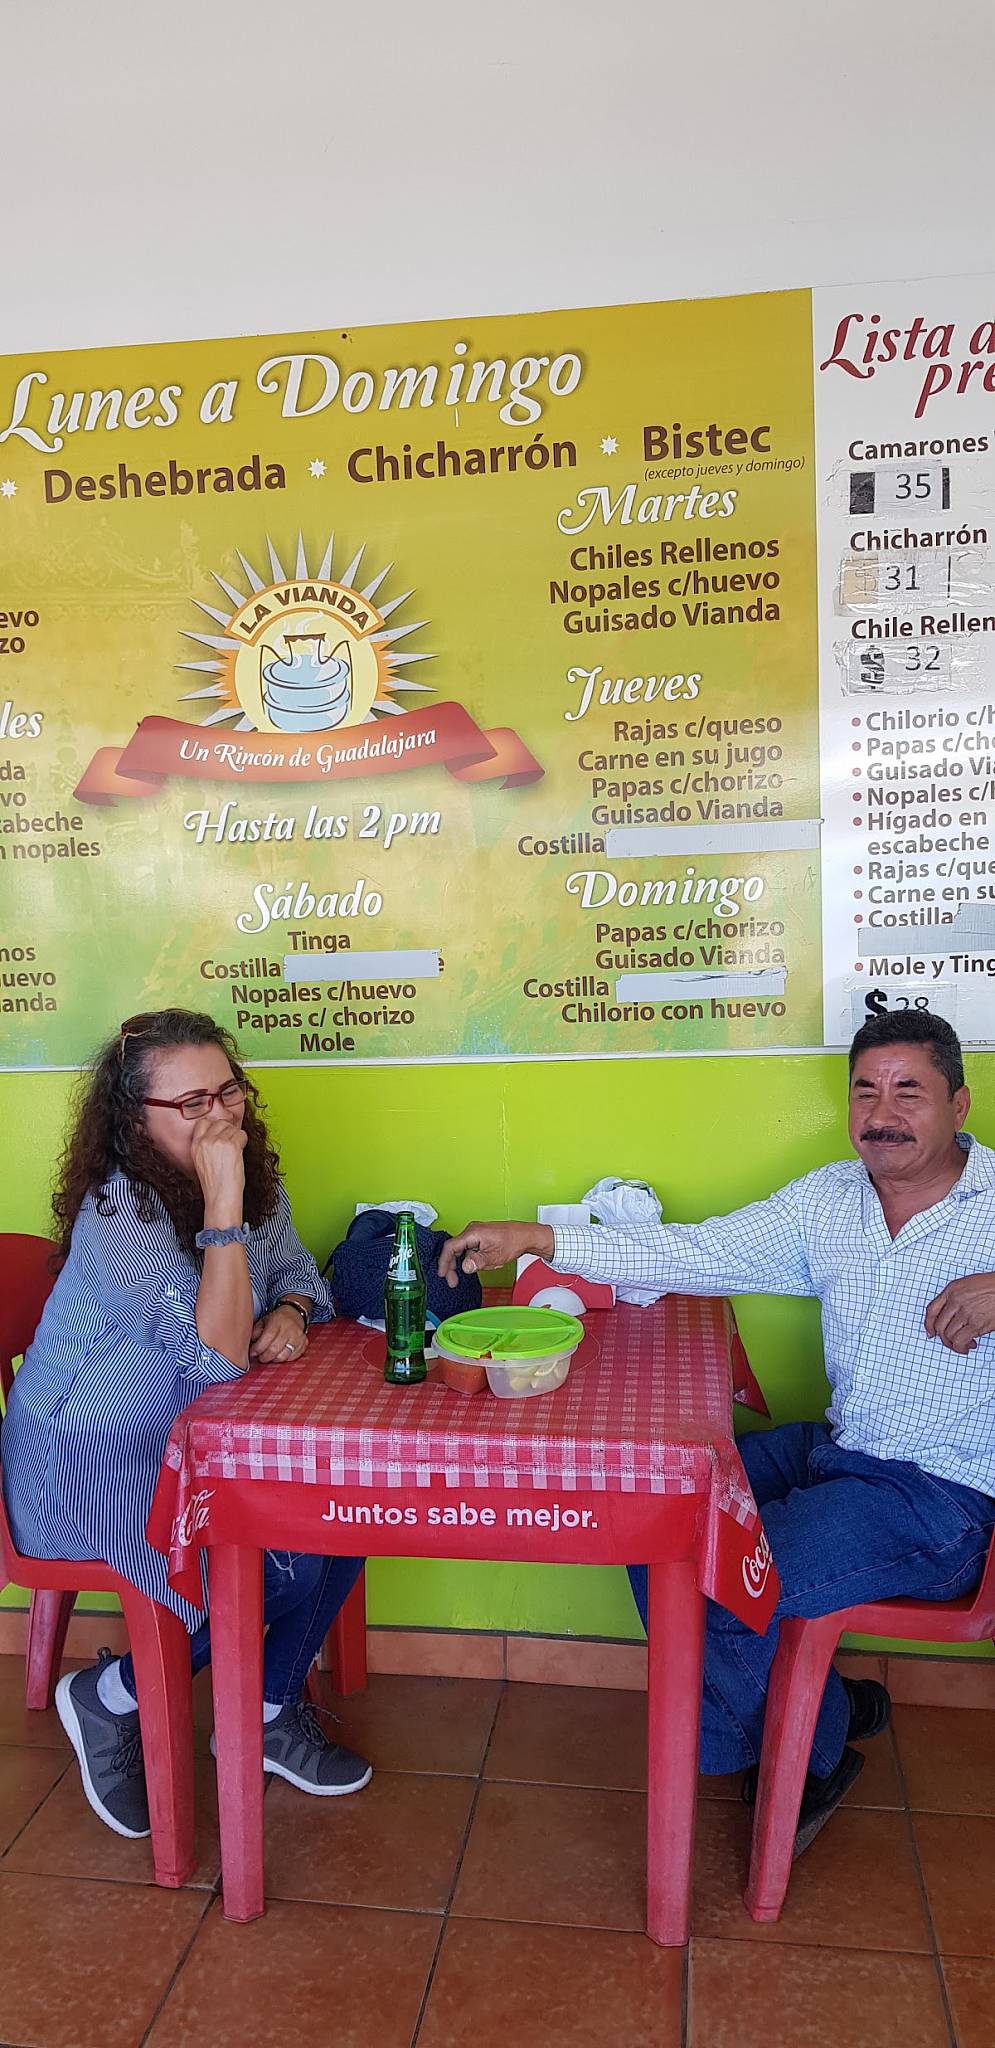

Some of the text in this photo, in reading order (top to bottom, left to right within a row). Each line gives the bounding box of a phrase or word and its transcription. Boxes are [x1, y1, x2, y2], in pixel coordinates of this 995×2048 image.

[820, 313, 955, 379] Lista
[0, 342, 582, 453] Lunes a Domingo
[848, 436, 989, 460] Camarones
[44, 423, 771, 503] Deshebrada Chicharrón Bistec
[644, 456, 805, 481] (excepto jueves y domingo)
[895, 473, 931, 499] 35
[557, 484, 738, 535] Martes
[850, 523, 987, 552] Chicharrón
[570, 537, 779, 571] Chiles Rellenos
[549, 570, 780, 607] Nopales c/huevo
[885, 565, 920, 591] 31
[239, 586, 371, 635] LA VIANDA
[563, 597, 780, 634] Guisado Vianda
[851, 616, 913, 639] Chile
[905, 645, 940, 671] 32
[564, 666, 701, 721] Jueves
[613, 716, 783, 744] Rajas c/queso
[866, 708, 960, 731] Chilorio
[179, 729, 437, 773] Un Rincón de Guadalajara
[578, 744, 783, 772] Carne en su jugo
[867, 737, 936, 760] Papas
[866, 757, 964, 781] Guisado
[591, 770, 783, 801] Papas c/chorizo
[867, 783, 962, 810] Nopales
[0, 811, 83, 834] abeche
[591, 797, 784, 826] Guisado Vianda
[868, 808, 987, 834] Hígado en
[183, 801, 441, 849] Hasta las 2 pm
[13, 837, 101, 863] nopales
[517, 831, 606, 856] Costilla
[867, 831, 989, 856] escabeche
[868, 861, 929, 883] Rajas
[565, 867, 765, 918] Domingo
[868, 885, 935, 904] Carne
[942, 886, 970, 901] en
[236, 880, 383, 934] Sábado
[868, 907, 953, 928] Costilla
[287, 931, 351, 953] Tinga
[595, 918, 785, 947] Papas c/chorizo
[200, 958, 281, 979] Costilla
[595, 943, 785, 970] Guisado Vianda
[869, 957, 926, 976] Mole
[931, 960, 945, 979] y
[0, 972, 56, 987] uevo
[523, 976, 610, 999] Costilla
[231, 981, 417, 1007] Nopales c/huevo
[236, 1006, 415, 1033] Papas c/ chorizo
[561, 997, 787, 1024] Chilorio con huevo
[300, 1032, 355, 1052] Mole
[321, 1500, 599, 1531] Juntos sabe mejor.
